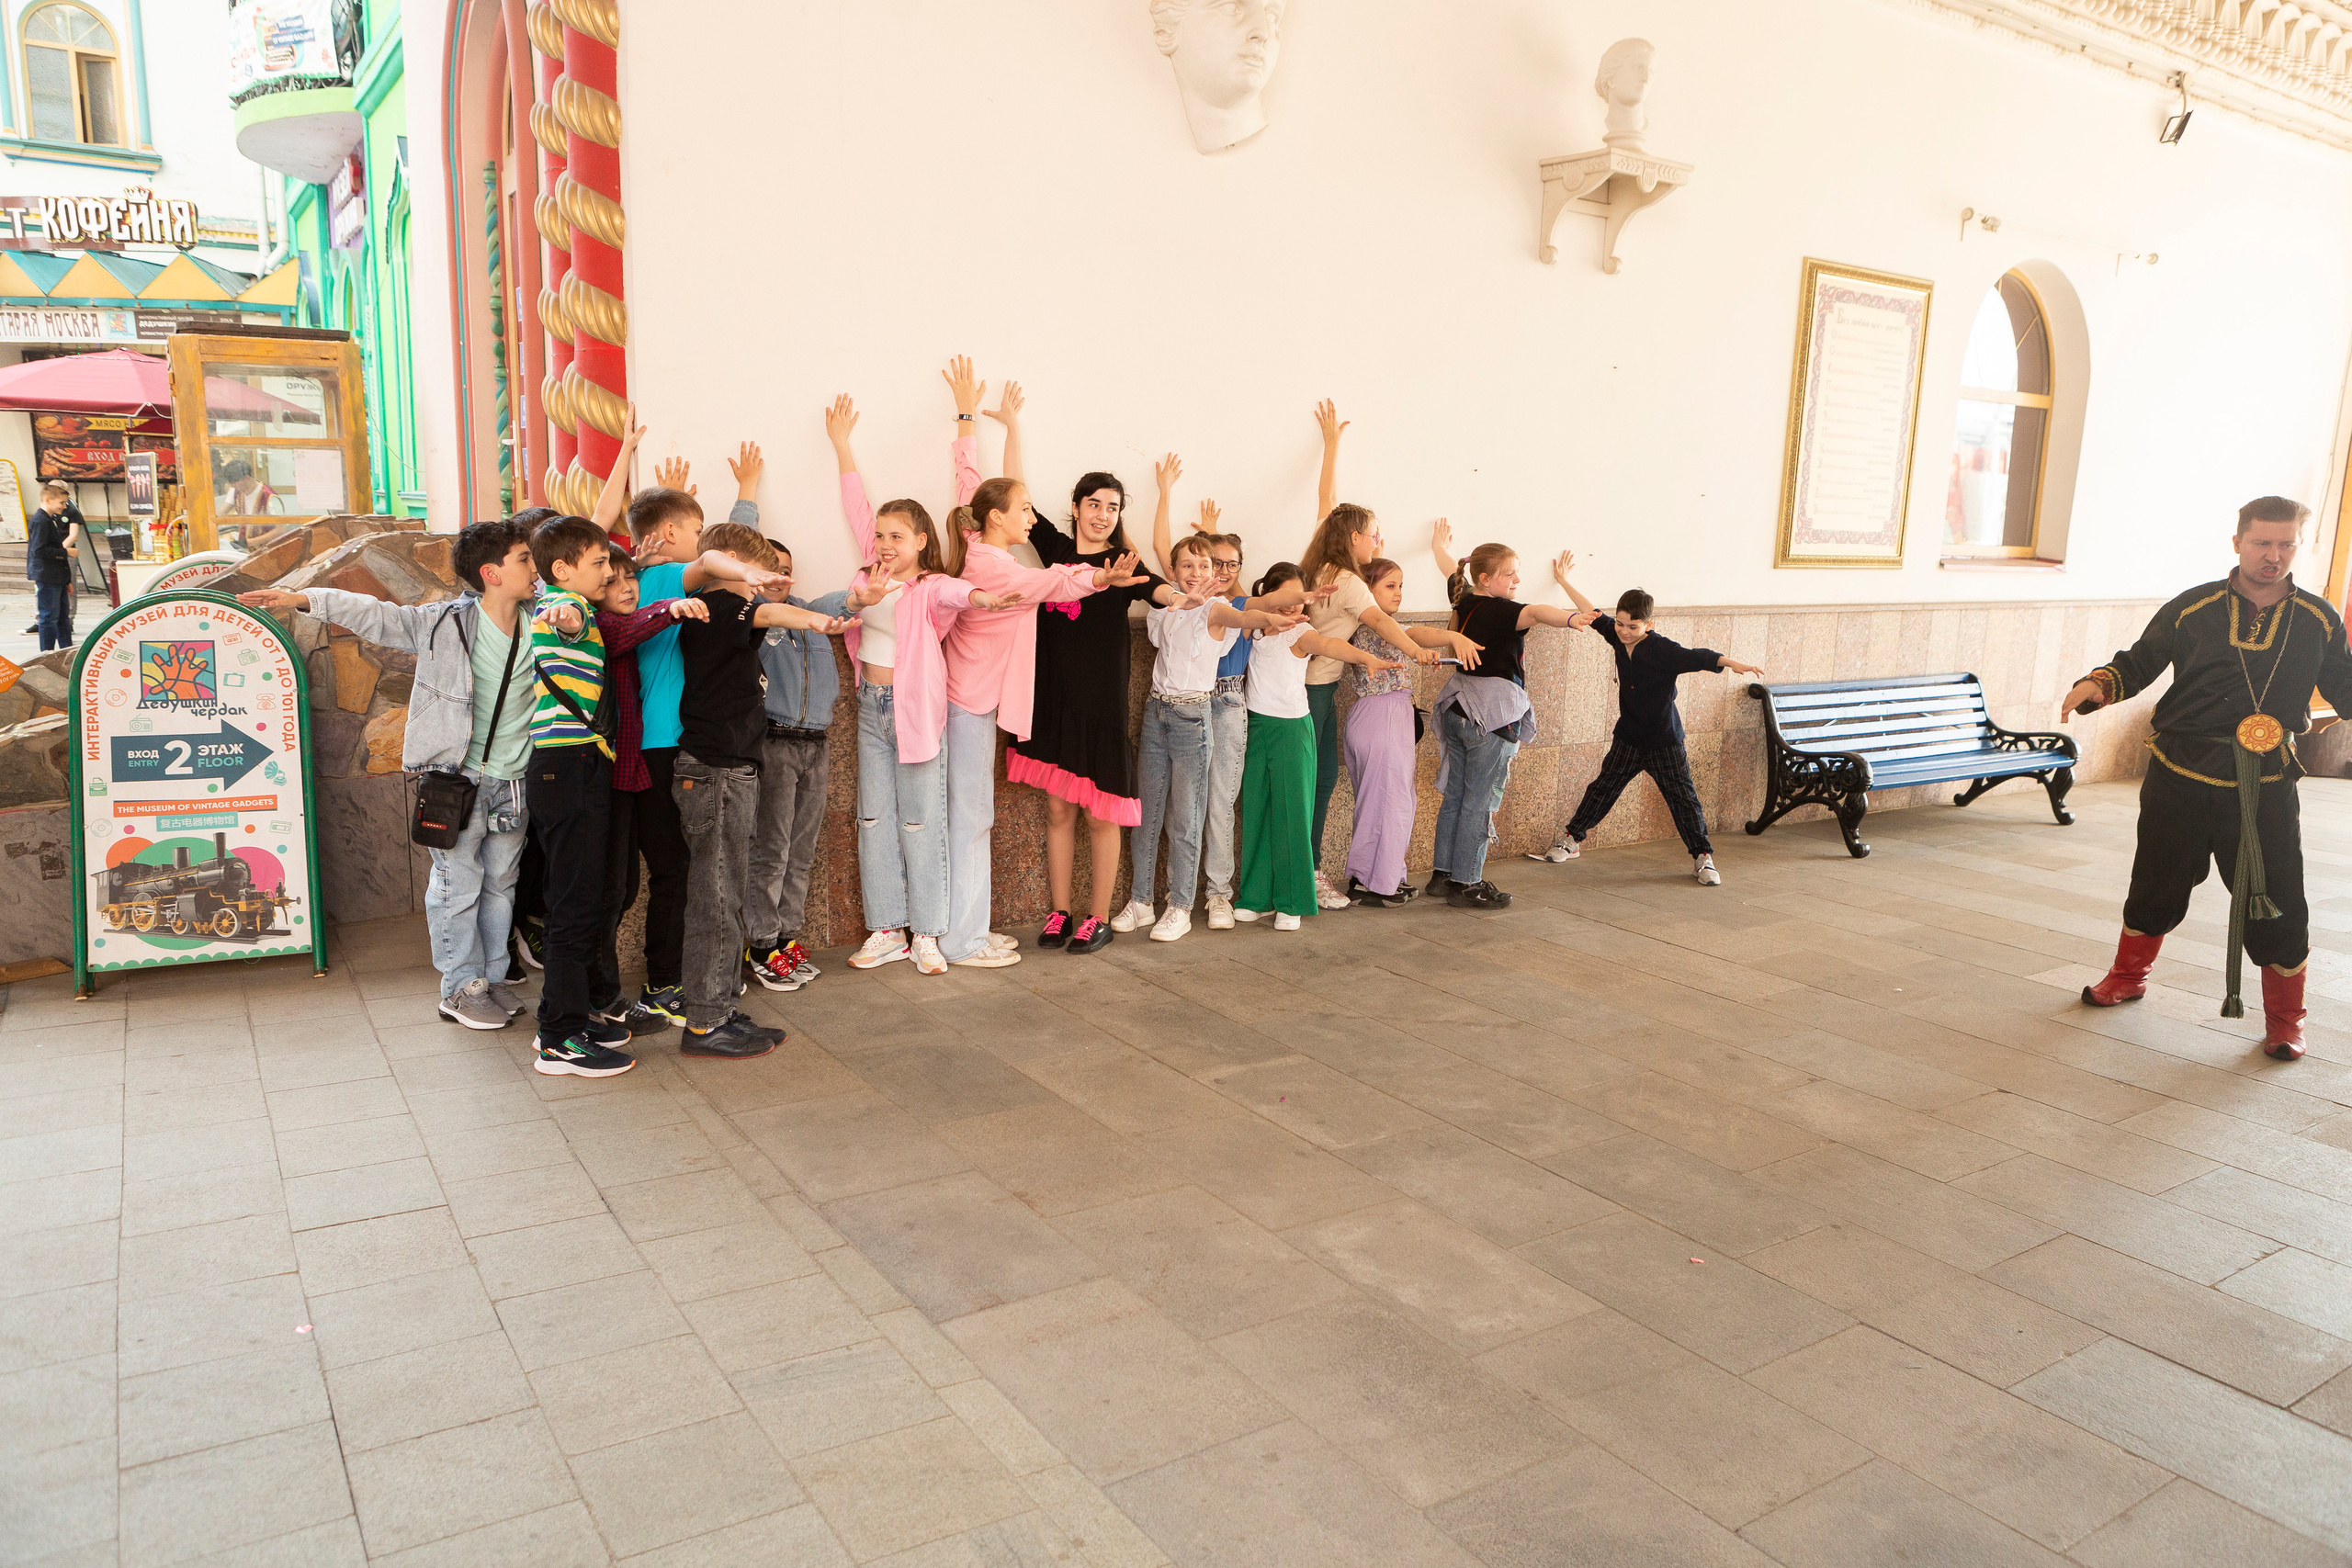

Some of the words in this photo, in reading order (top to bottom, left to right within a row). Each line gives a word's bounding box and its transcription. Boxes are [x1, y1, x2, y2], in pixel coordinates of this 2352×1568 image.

[39, 186, 194, 243] КОФЕЙНЯ
[0, 311, 40, 337] ТАРАЯ
[44, 312, 101, 337] МОСКВА
[87, 451, 115, 462] ВХОД
[160, 568, 198, 590] МУЗЕЙ
[202, 566, 229, 576] ДЛ
[173, 605, 209, 617] ДЛЯ
[114, 606, 168, 638] МУЗЕЙ
[212, 609, 264, 637] ДЕТЕЙ
[262, 637, 281, 654] ОТ
[275, 656, 286, 664] 1
[276, 667, 292, 688] ДО
[85, 637, 118, 761] ИНТЕРАКТИВНЫЙ
[282, 692, 294, 711] 101
[190, 702, 248, 720] чердак
[282, 716, 296, 752] ГОДА
[128, 750, 160, 759] ВХОД
[164, 739, 194, 775] 2
[198, 743, 244, 756] ЭТАЖ
[129, 760, 160, 768] ENTRY
[198, 756, 243, 768] FLOOR
[137, 804, 175, 813] MUSEUM
[192, 801, 231, 810] VINTAGE
[232, 798, 274, 808] GADGETS
[159, 815, 235, 829] 复古电器博物馆
